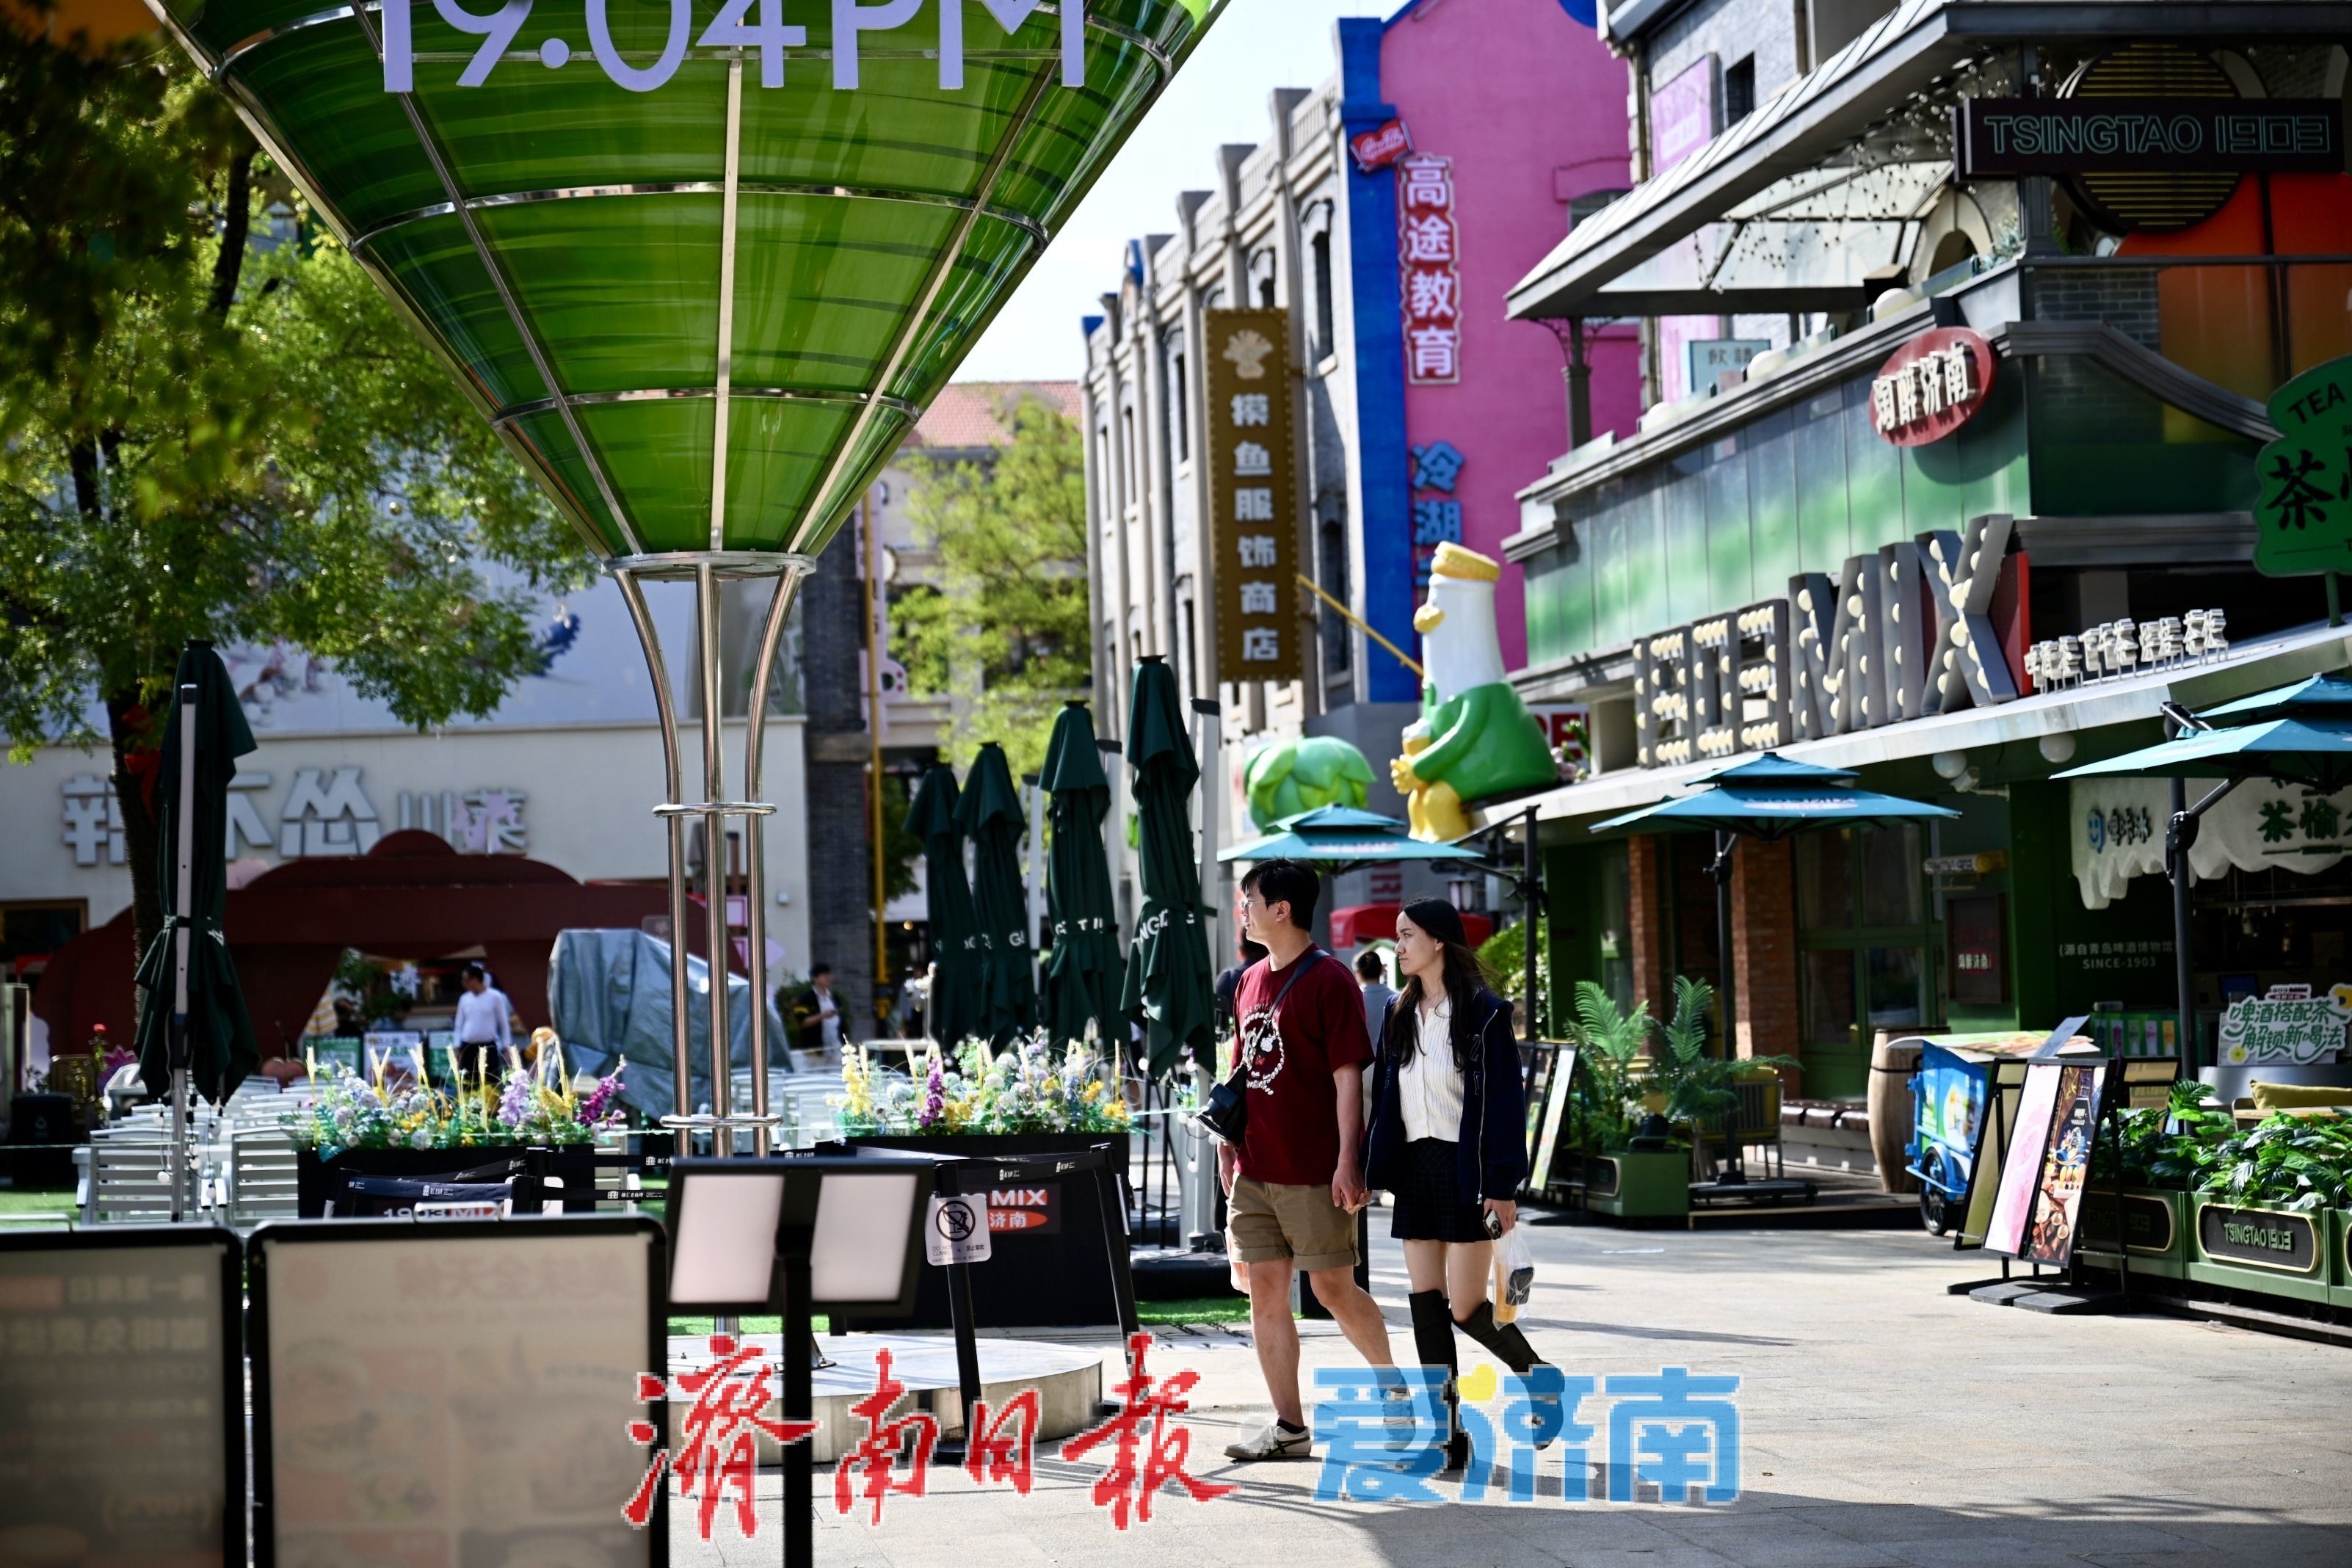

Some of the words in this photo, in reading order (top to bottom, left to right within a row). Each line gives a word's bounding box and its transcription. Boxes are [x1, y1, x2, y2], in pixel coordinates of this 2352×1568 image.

[1983, 115, 2203, 154] TSINGTAO
[2215, 115, 2330, 154] 1903
[1405, 156, 1456, 379] 高途教育
[2287, 381, 2347, 424] TEA
[1231, 393, 1280, 662] 摸鱼服饰商店
[1412, 440, 1466, 586] 冷湖
[2224, 999, 2349, 1037] 啤酒搭配茶
[2242, 1023, 2342, 1061] 解锁新喝法
[2224, 1222, 2266, 1247] TSINGTAO
